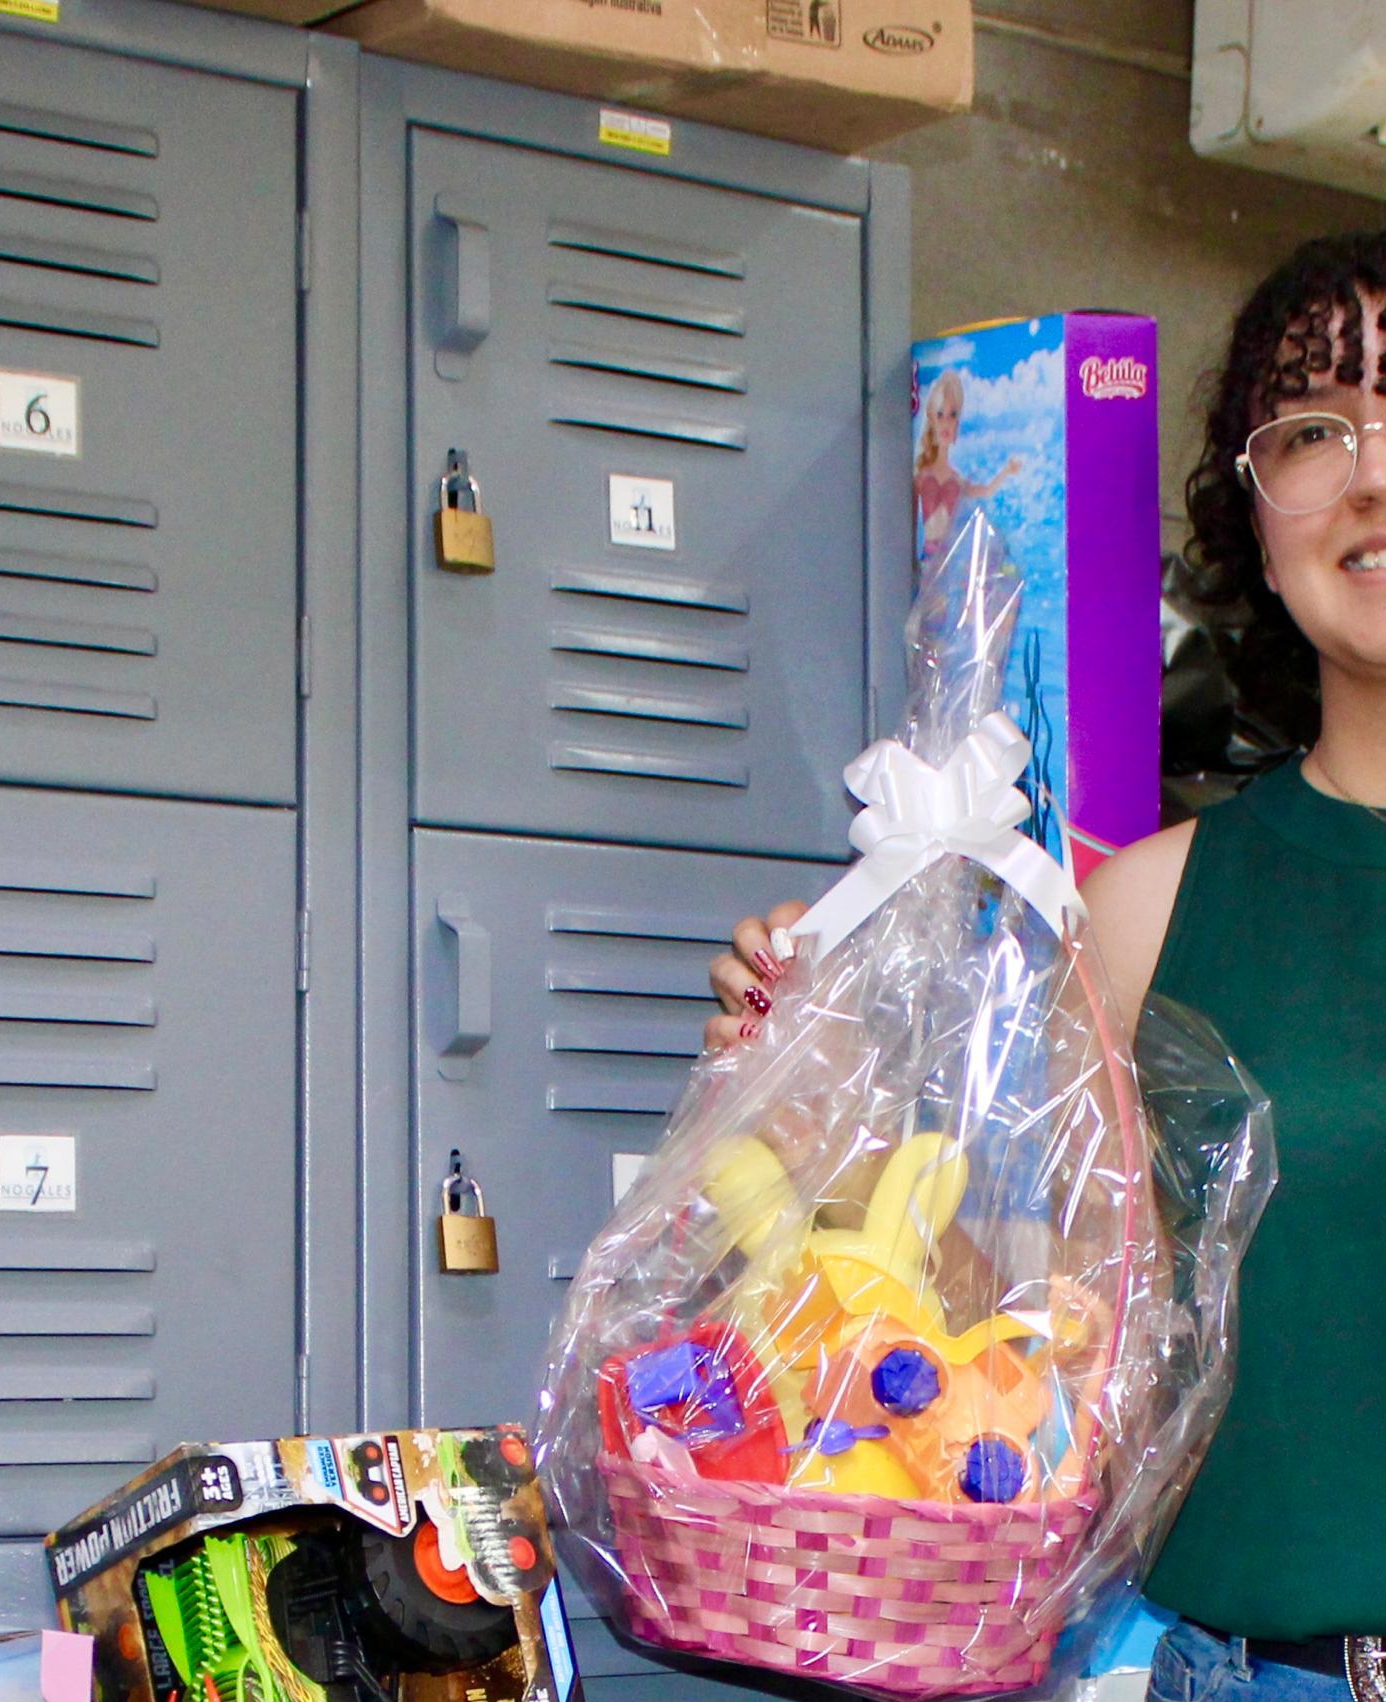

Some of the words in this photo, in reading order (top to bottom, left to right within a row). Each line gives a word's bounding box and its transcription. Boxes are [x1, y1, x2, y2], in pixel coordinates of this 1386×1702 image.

[873, 29, 926, 52] ADAMS
[1, 422, 75, 440] NOLES
[25, 394, 50, 435] 6
[25, 1165, 49, 1205] 7
[201, 1466, 222, 1501] 3+
[217, 1465, 234, 1501] AGES
[109, 1478, 182, 1549] FRICTION
[54, 1524, 110, 1586] POWER
